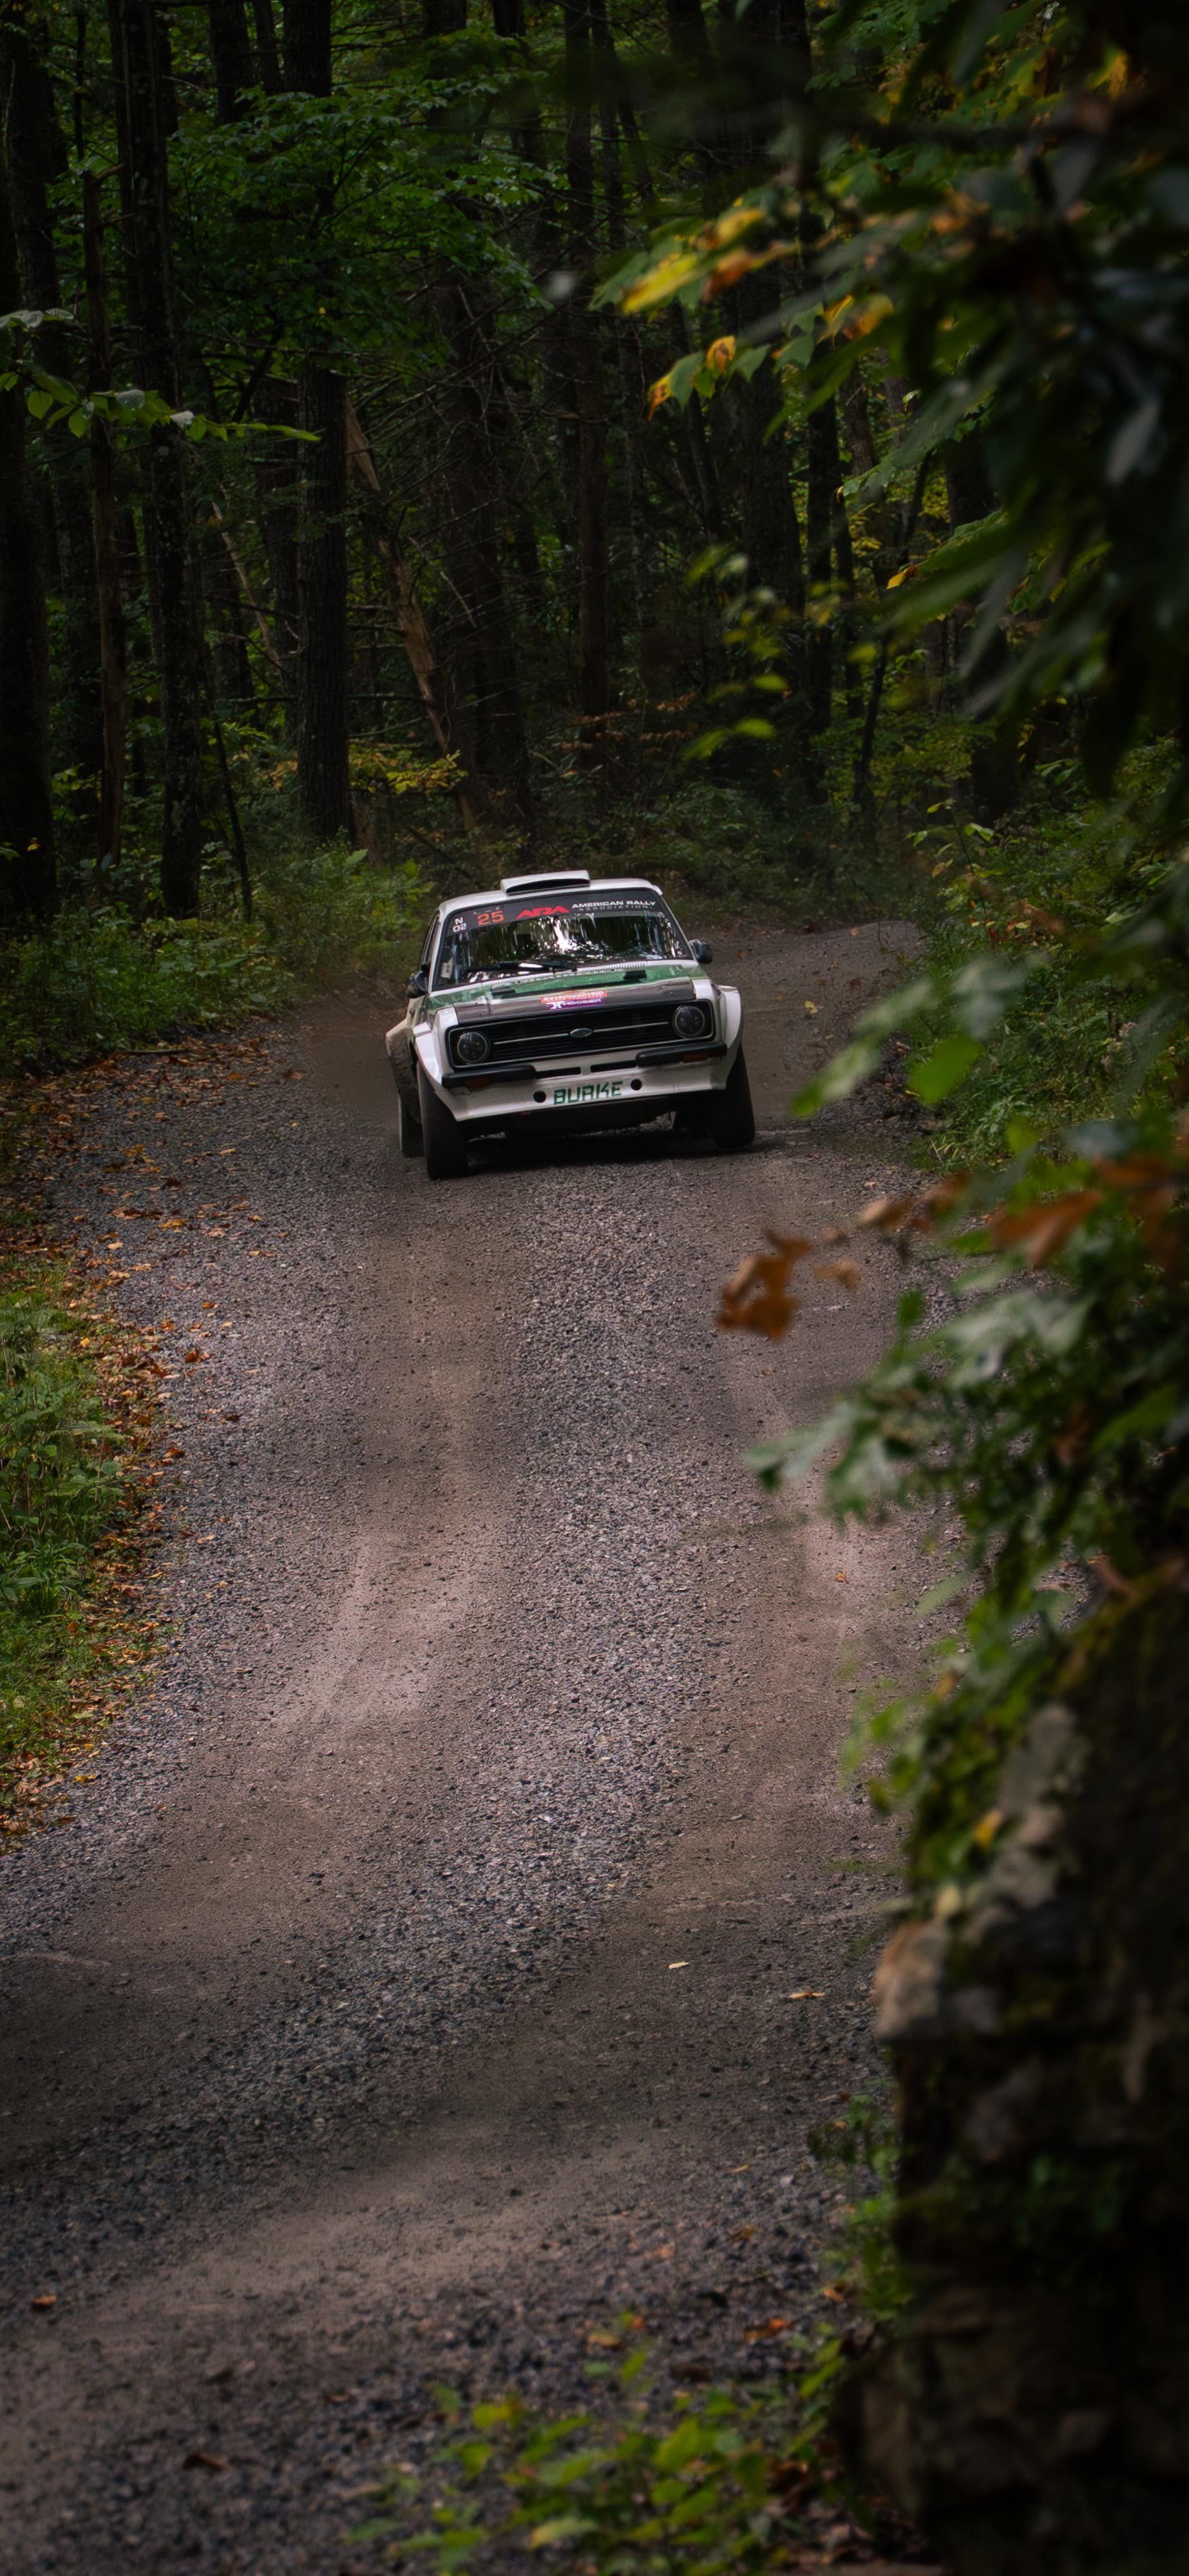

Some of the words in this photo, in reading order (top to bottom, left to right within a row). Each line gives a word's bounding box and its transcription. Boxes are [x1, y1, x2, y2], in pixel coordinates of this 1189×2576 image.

[572, 900, 624, 909] AMERICAN
[477, 910, 504, 926] 25
[517, 905, 570, 920] ARA
[455, 916, 464, 925] N
[452, 923, 468, 933] 02
[553, 1081, 623, 1105] BURKE
